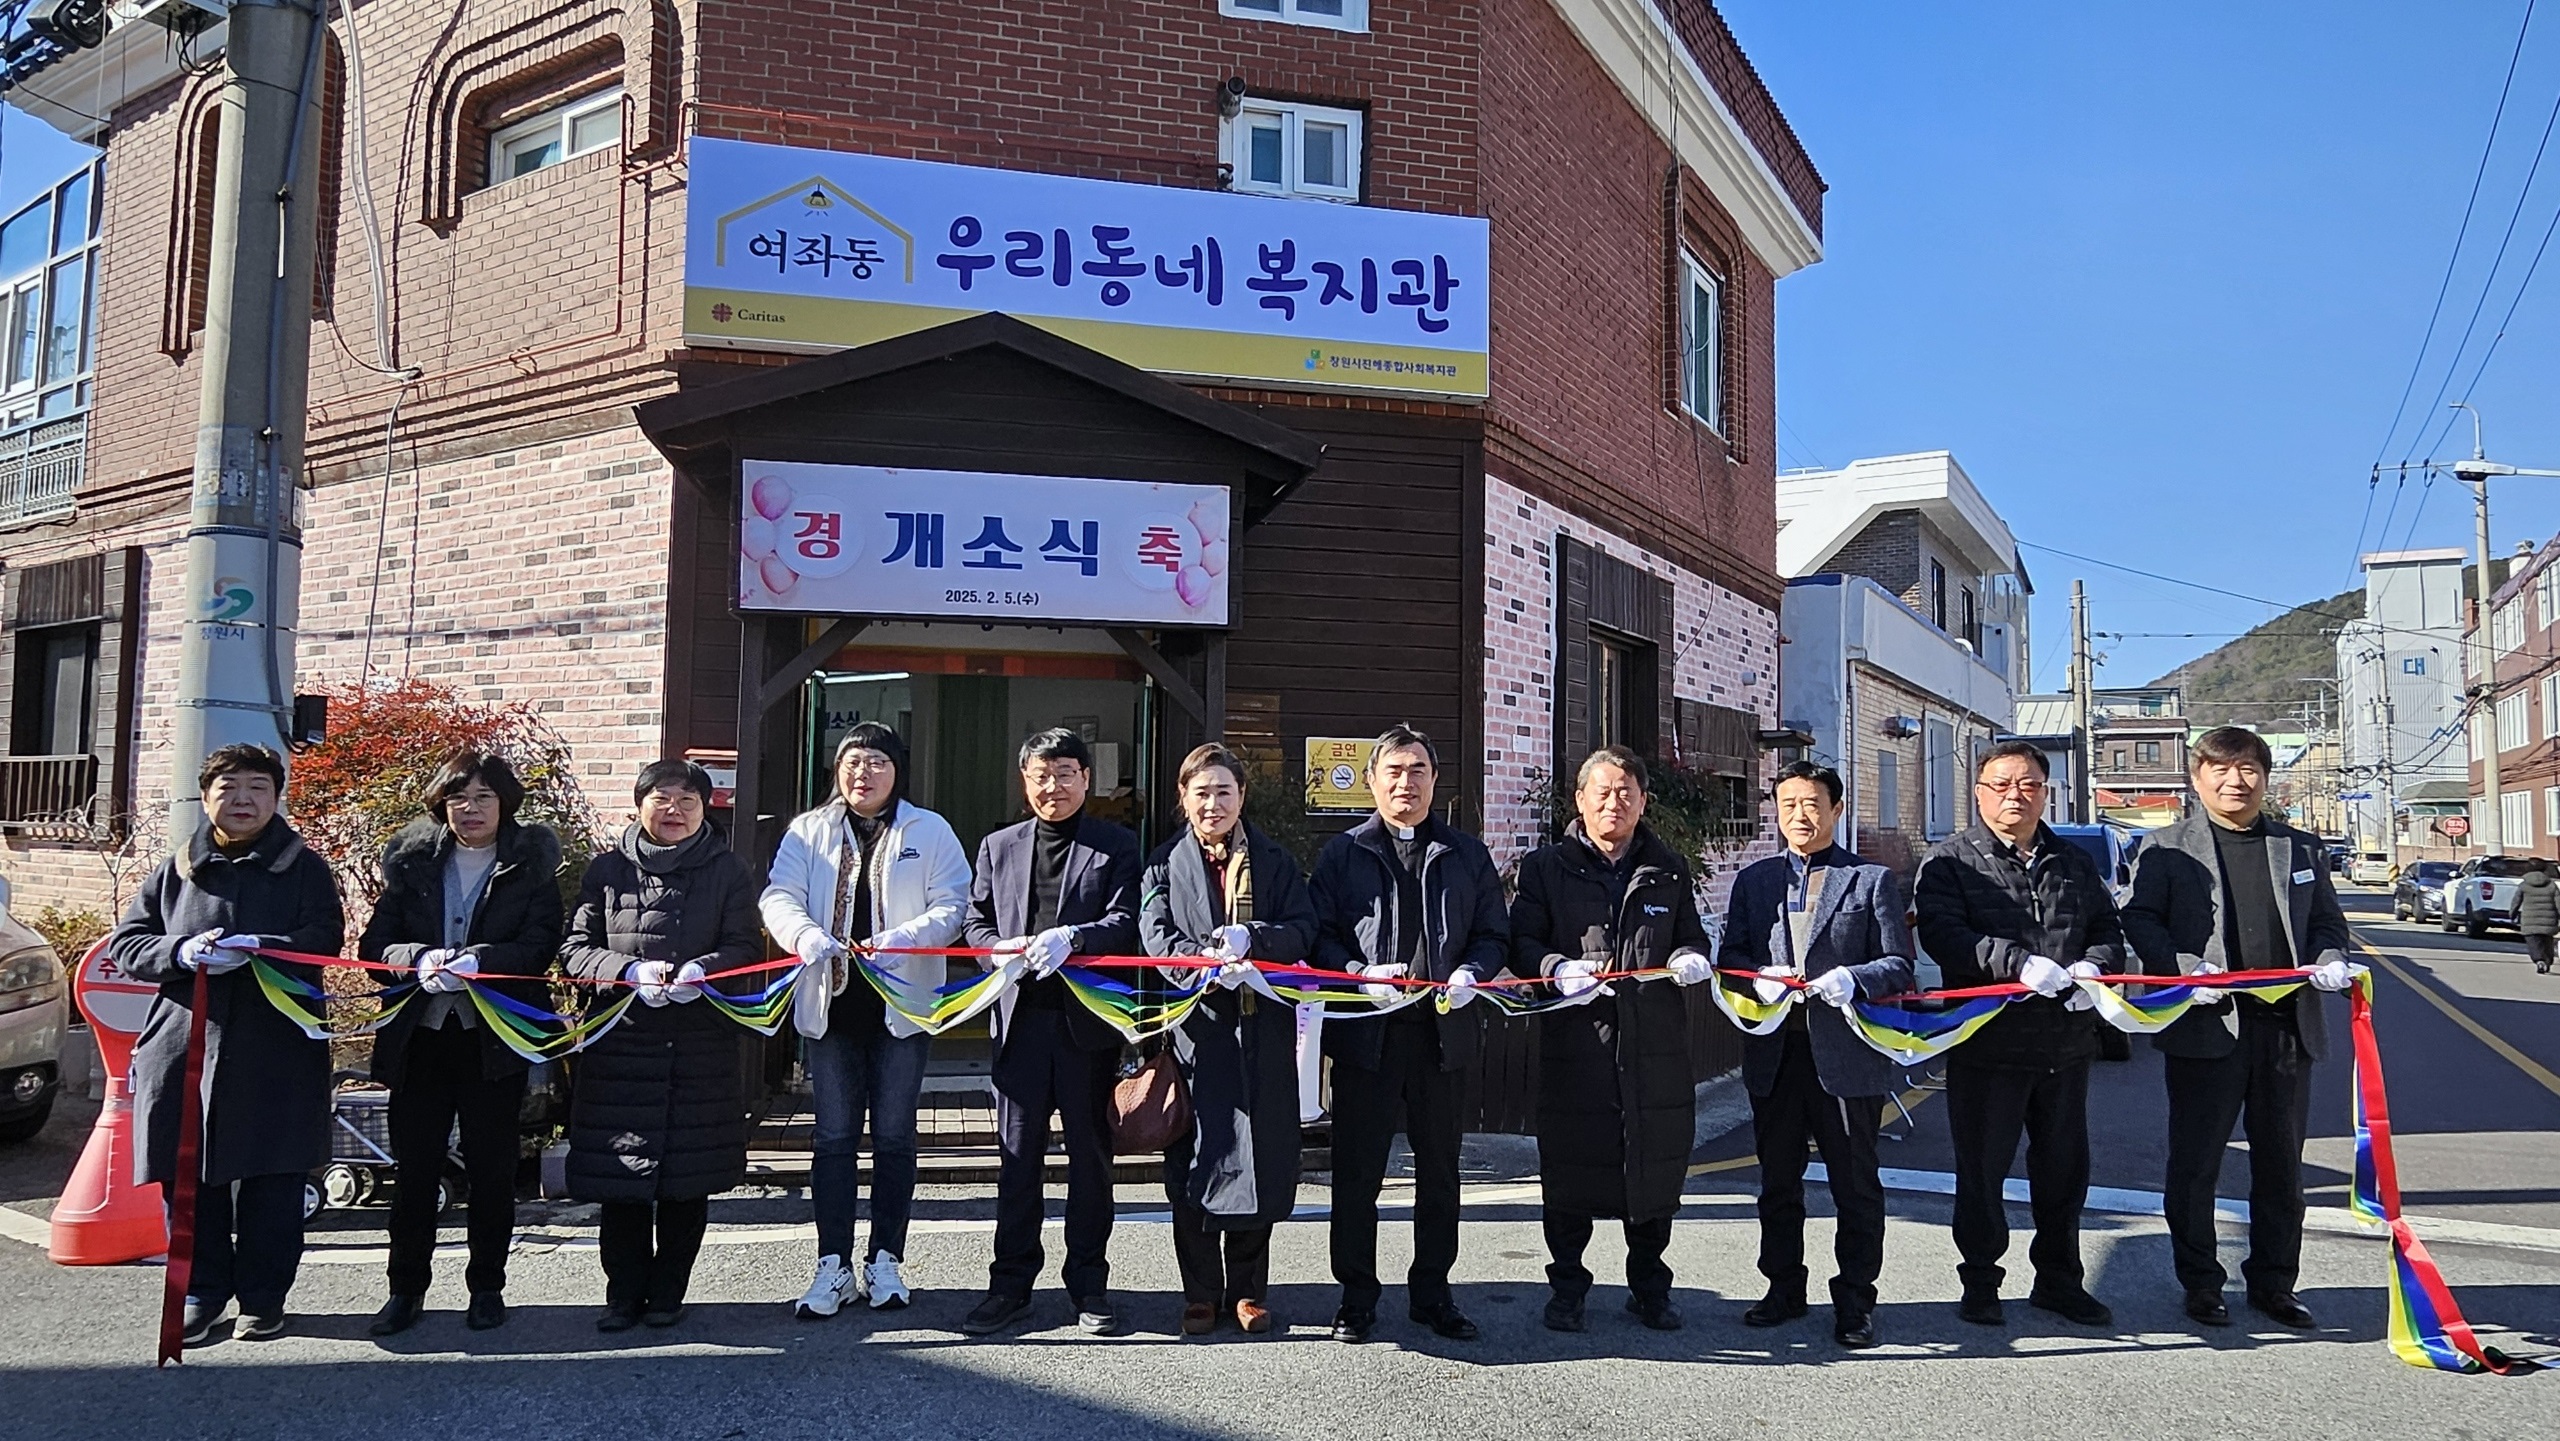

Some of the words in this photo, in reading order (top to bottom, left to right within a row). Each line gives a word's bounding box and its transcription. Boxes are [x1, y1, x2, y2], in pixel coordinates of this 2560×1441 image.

[749, 229, 885, 280] 여좌동
[936, 215, 1224, 306] 우리동네
[1246, 238, 1460, 333] 복지관
[738, 309, 786, 323] Caritas
[793, 512, 841, 559] 경
[881, 512, 1099, 577] 개소식
[1137, 526, 1183, 573] 축
[945, 589, 982, 604] 2025.
[987, 591, 1000, 604] 2.
[1004, 591, 1040, 606] 5.(수)
[1331, 743, 1357, 757] 금연
